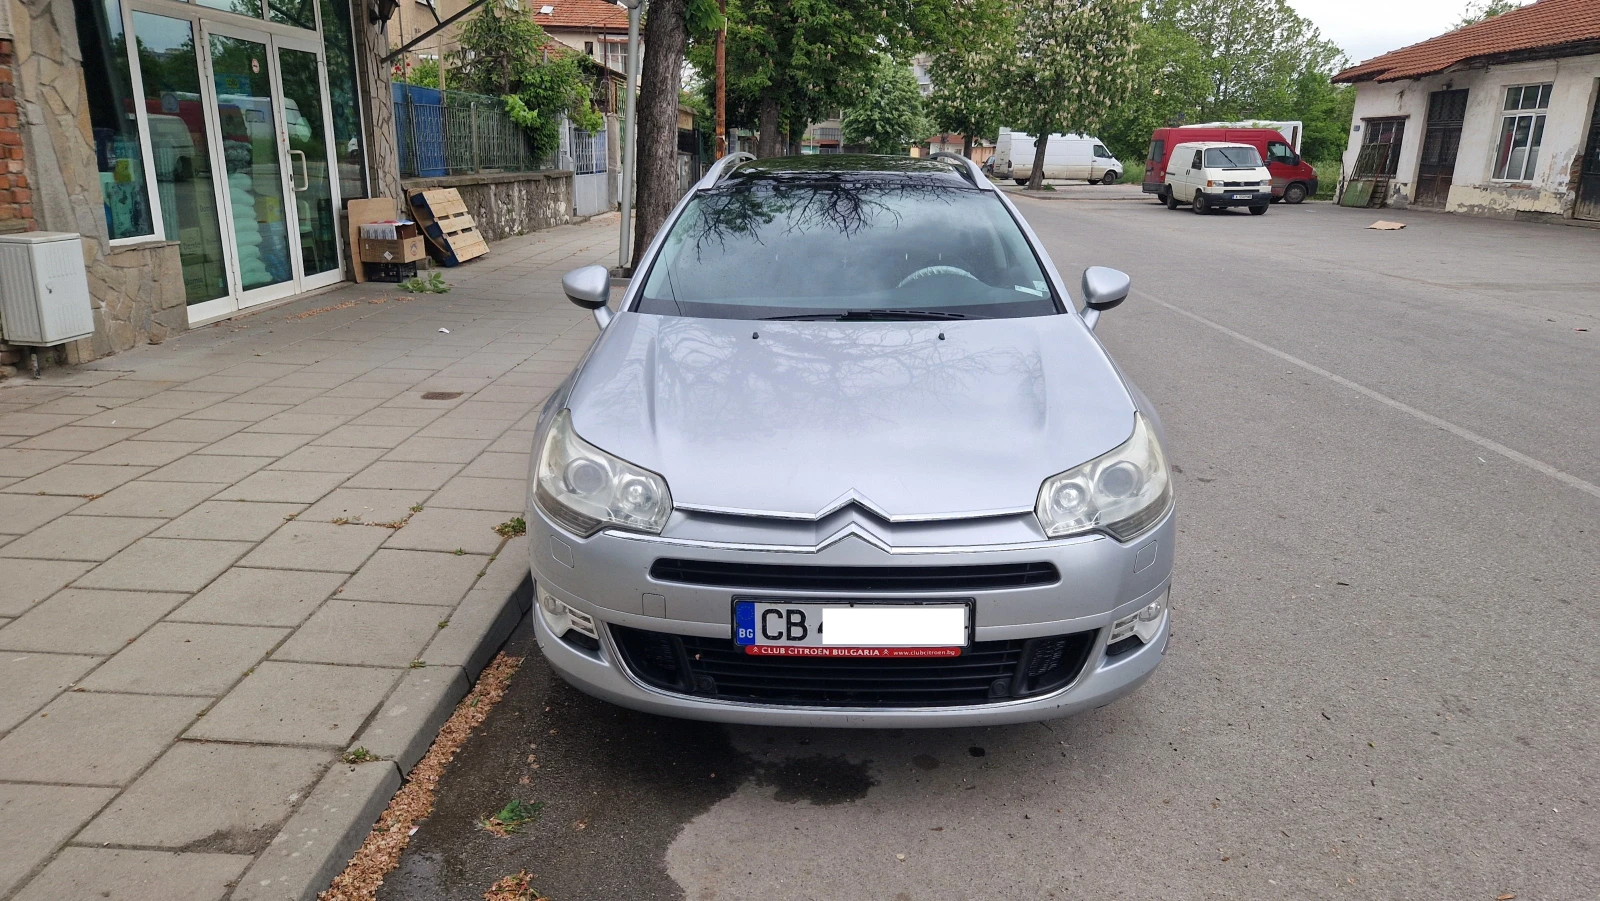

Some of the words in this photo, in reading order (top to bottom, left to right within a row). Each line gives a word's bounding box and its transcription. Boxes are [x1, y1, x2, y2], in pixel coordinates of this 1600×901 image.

[761, 608, 808, 641] CB
[739, 628, 754, 639] BG
[832, 648, 880, 656] BULGARIA
